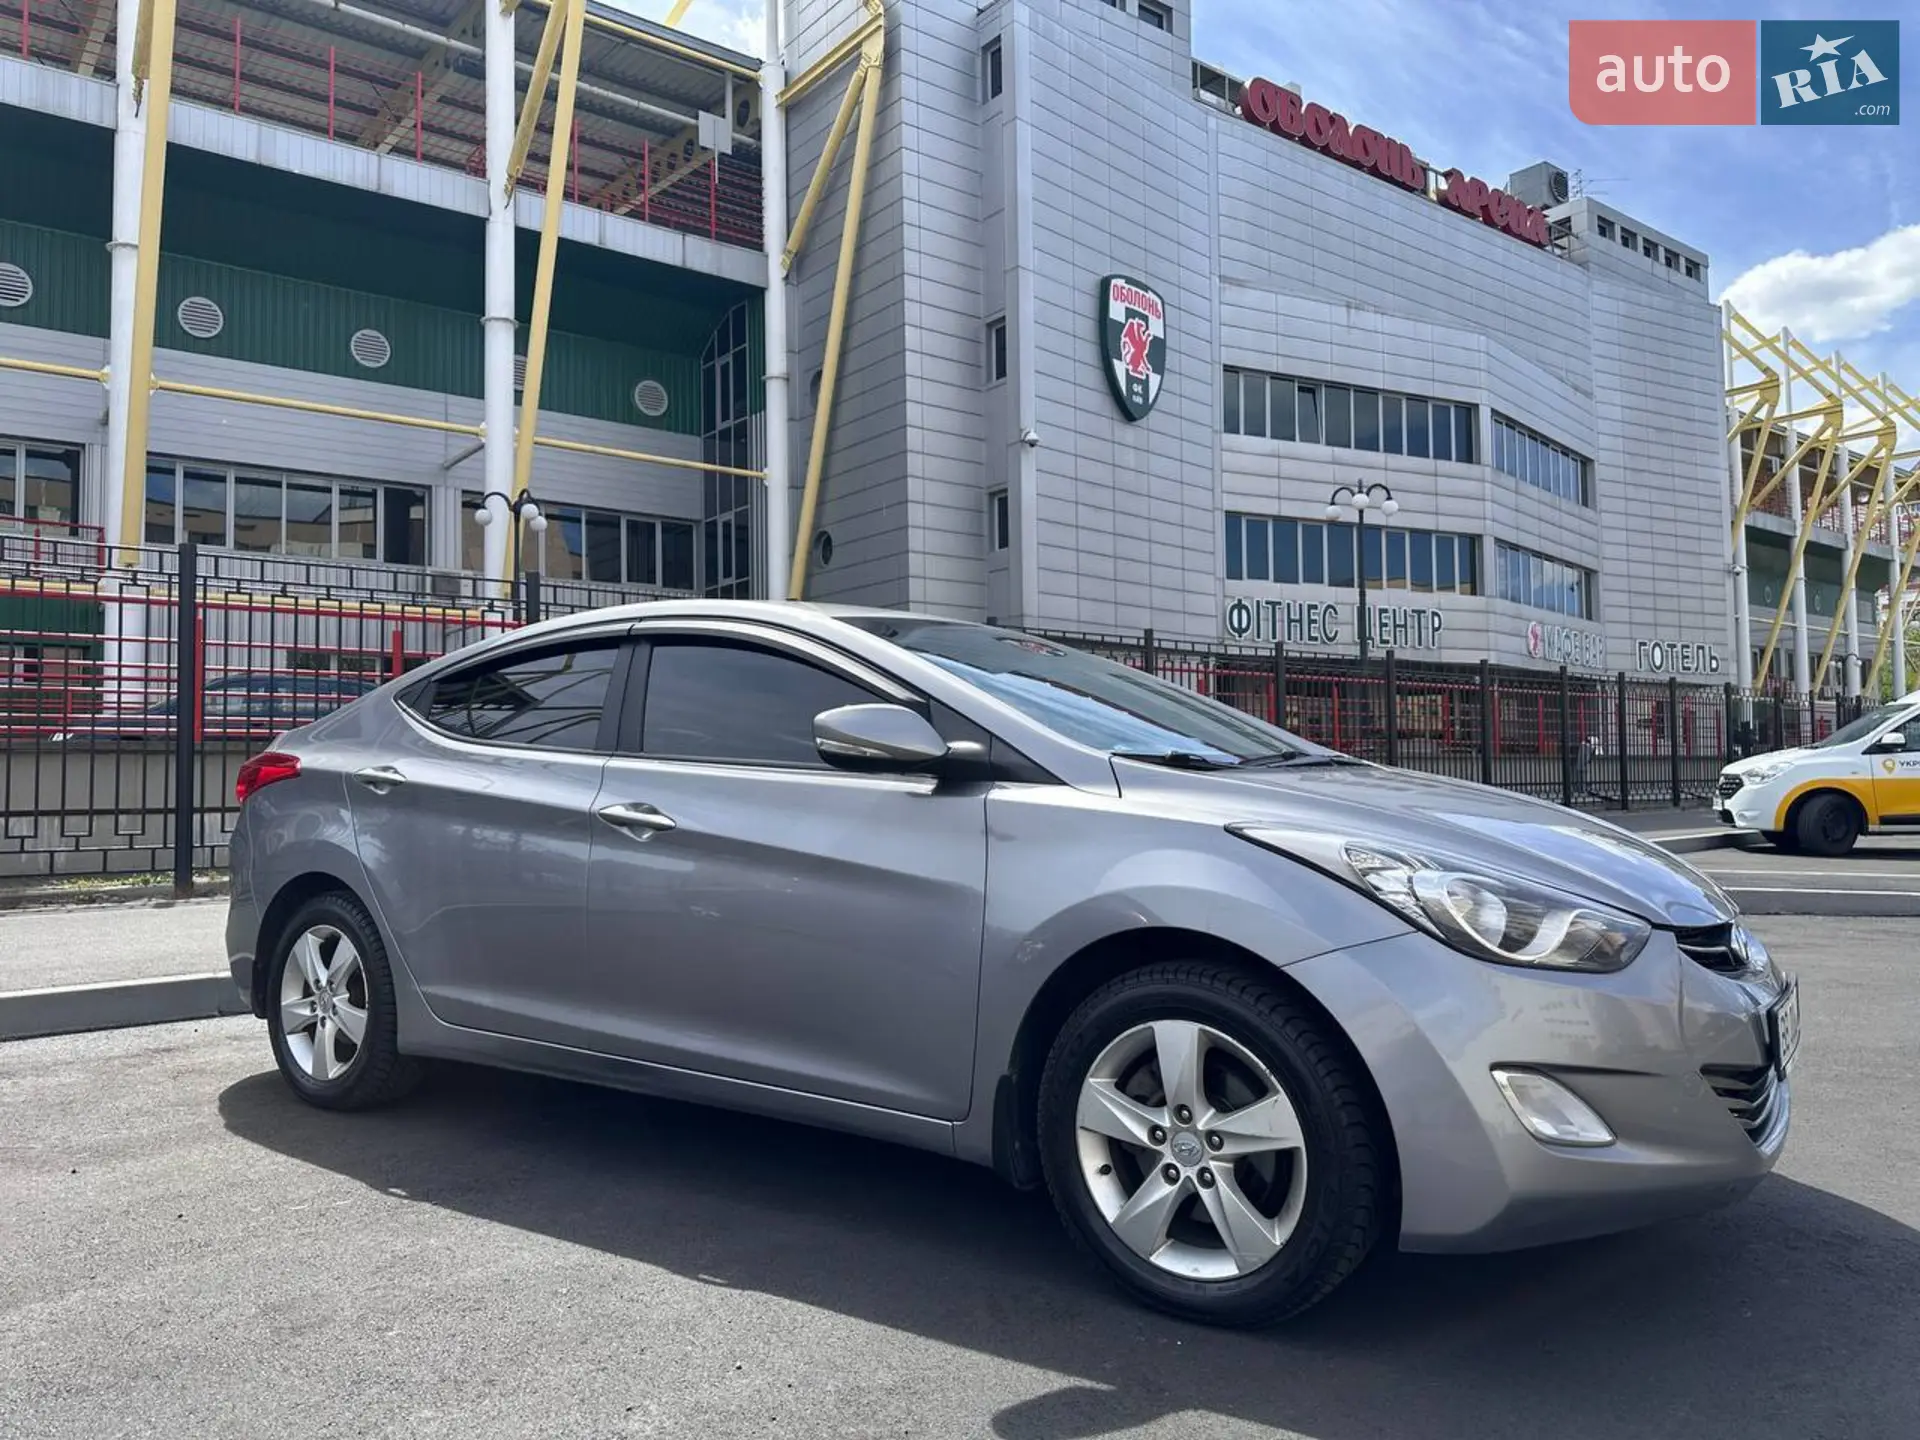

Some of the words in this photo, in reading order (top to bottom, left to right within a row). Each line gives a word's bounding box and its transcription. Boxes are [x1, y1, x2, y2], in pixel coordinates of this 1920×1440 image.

[1112, 283, 1162, 320] ОБОЛОНЬ
[1227, 598, 1340, 644] ФІТНЕС
[1636, 639, 1721, 674] ГОТЕЛЬ
